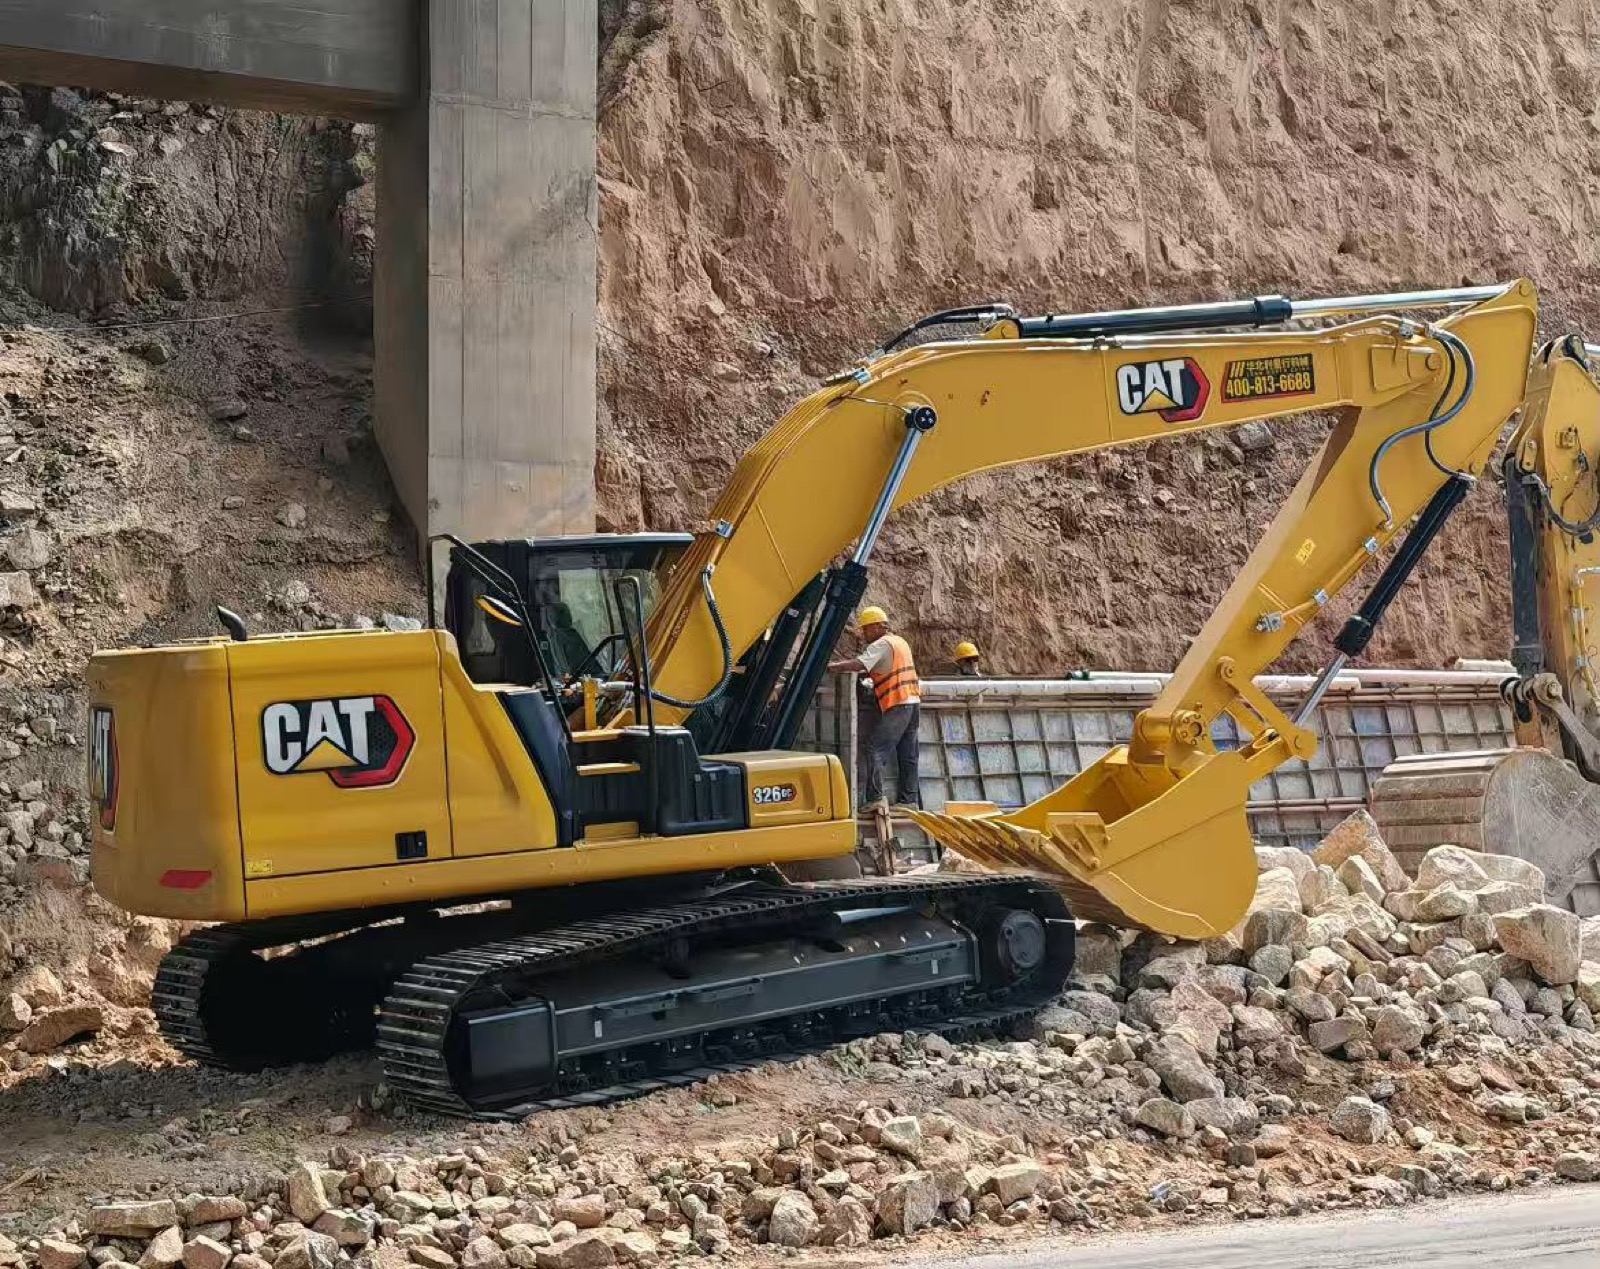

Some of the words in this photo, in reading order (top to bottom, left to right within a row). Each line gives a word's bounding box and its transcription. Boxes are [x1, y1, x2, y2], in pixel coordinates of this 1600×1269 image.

[1118, 359, 1185, 414] CAT
[1226, 371, 1311, 397] 400-813-6688
[263, 697, 375, 774] CAT
[754, 786, 781, 804] 326
